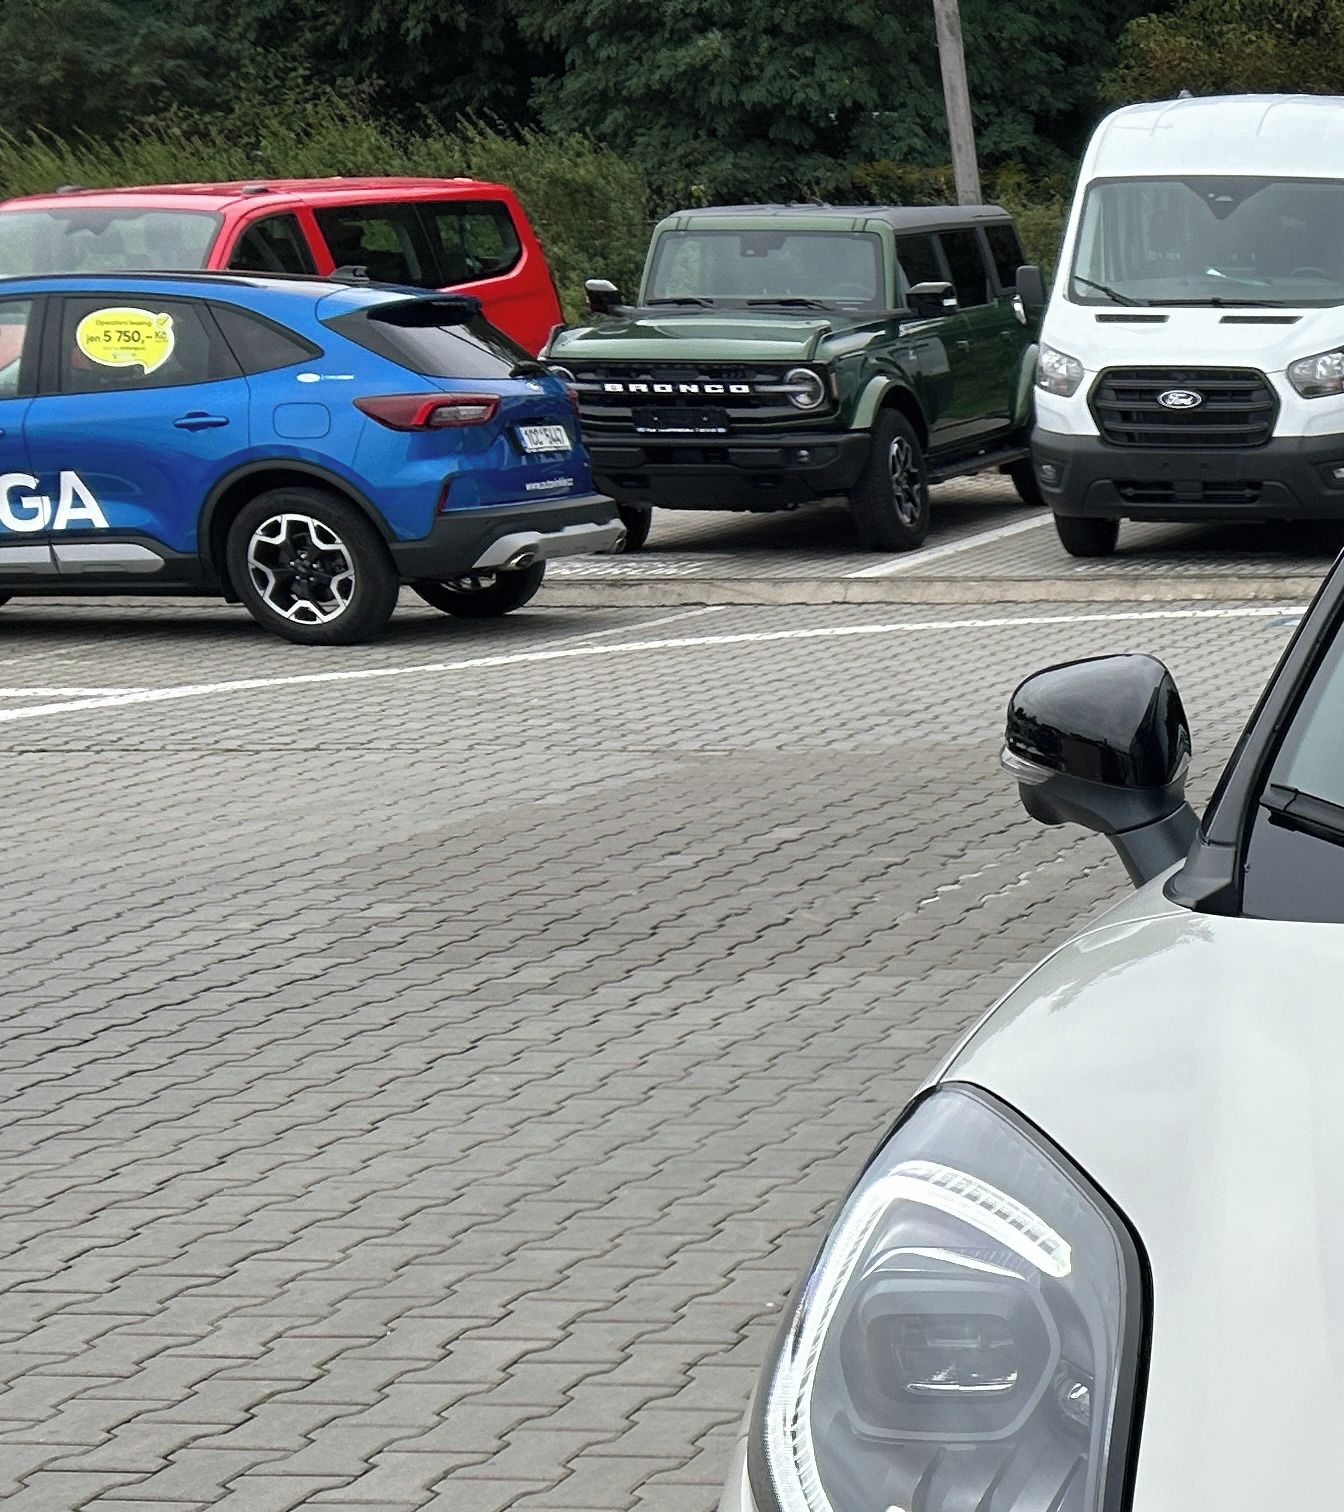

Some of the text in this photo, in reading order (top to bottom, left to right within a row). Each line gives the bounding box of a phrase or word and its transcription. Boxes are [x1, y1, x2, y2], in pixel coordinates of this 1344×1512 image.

[86, 335, 100, 344] jen
[103, 330, 112, 342] 5
[603, 383, 750, 393] BRONCO
